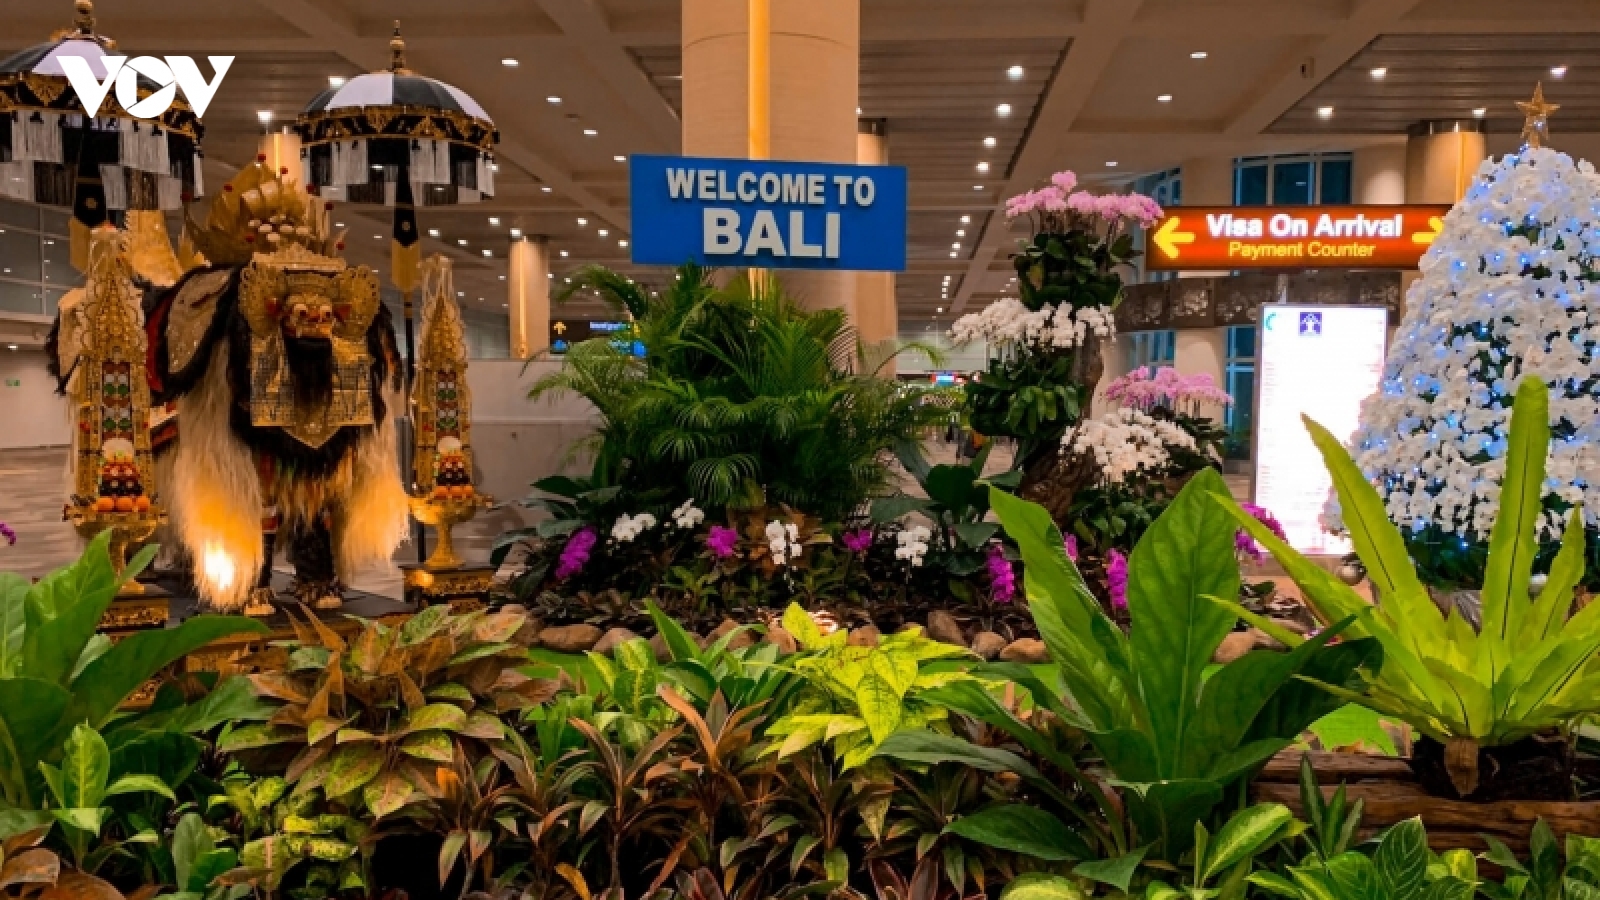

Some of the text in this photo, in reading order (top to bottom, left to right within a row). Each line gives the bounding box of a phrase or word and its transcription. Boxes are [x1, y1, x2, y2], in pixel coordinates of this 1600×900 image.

[666, 167, 876, 207] WELCOME TO
[703, 207, 841, 259] BALI
[1206, 213, 1403, 237] Visa On Arrival
[1228, 242, 1376, 260] Payment Counter
